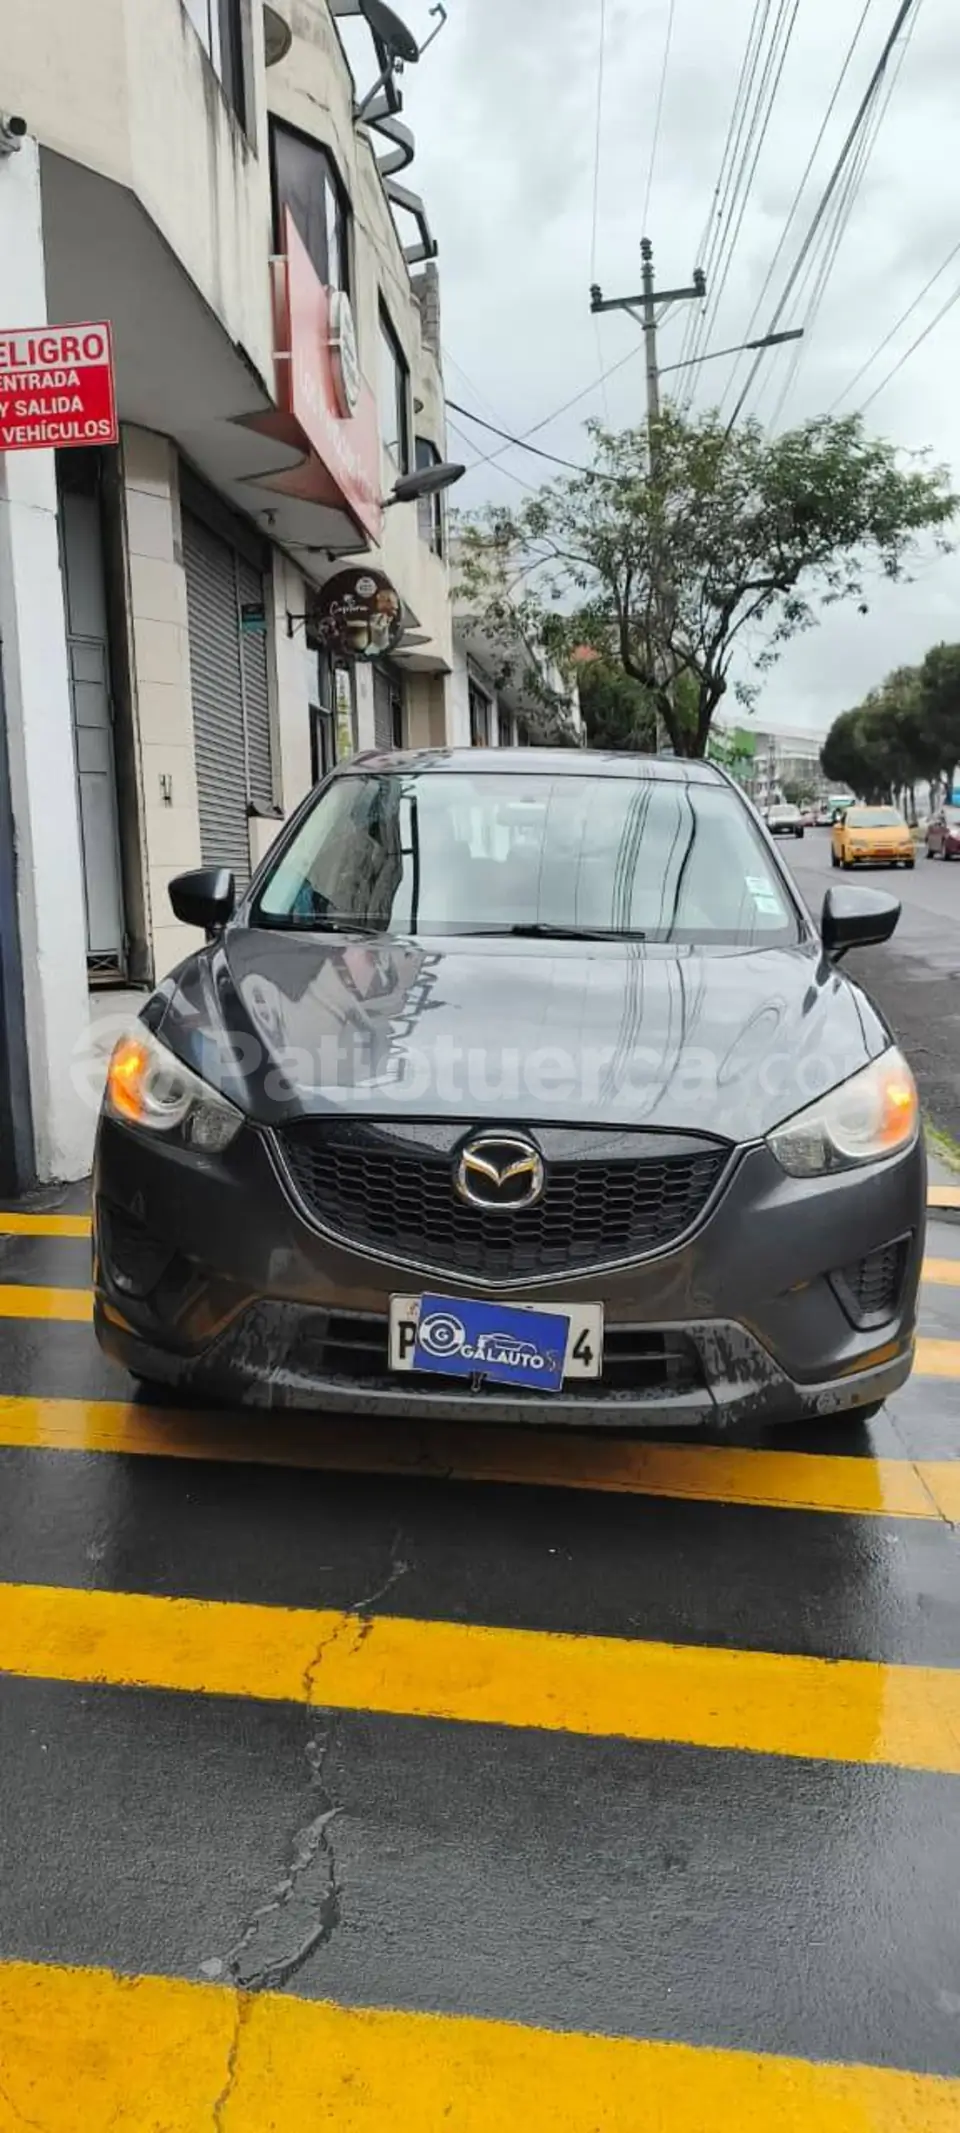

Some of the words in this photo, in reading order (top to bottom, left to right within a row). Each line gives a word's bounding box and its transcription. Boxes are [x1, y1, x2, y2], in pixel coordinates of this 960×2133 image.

[0, 401, 9, 417] Y
[15, 395, 84, 416] SALIDA
[2, 419, 111, 443] VEHÍCULOS
